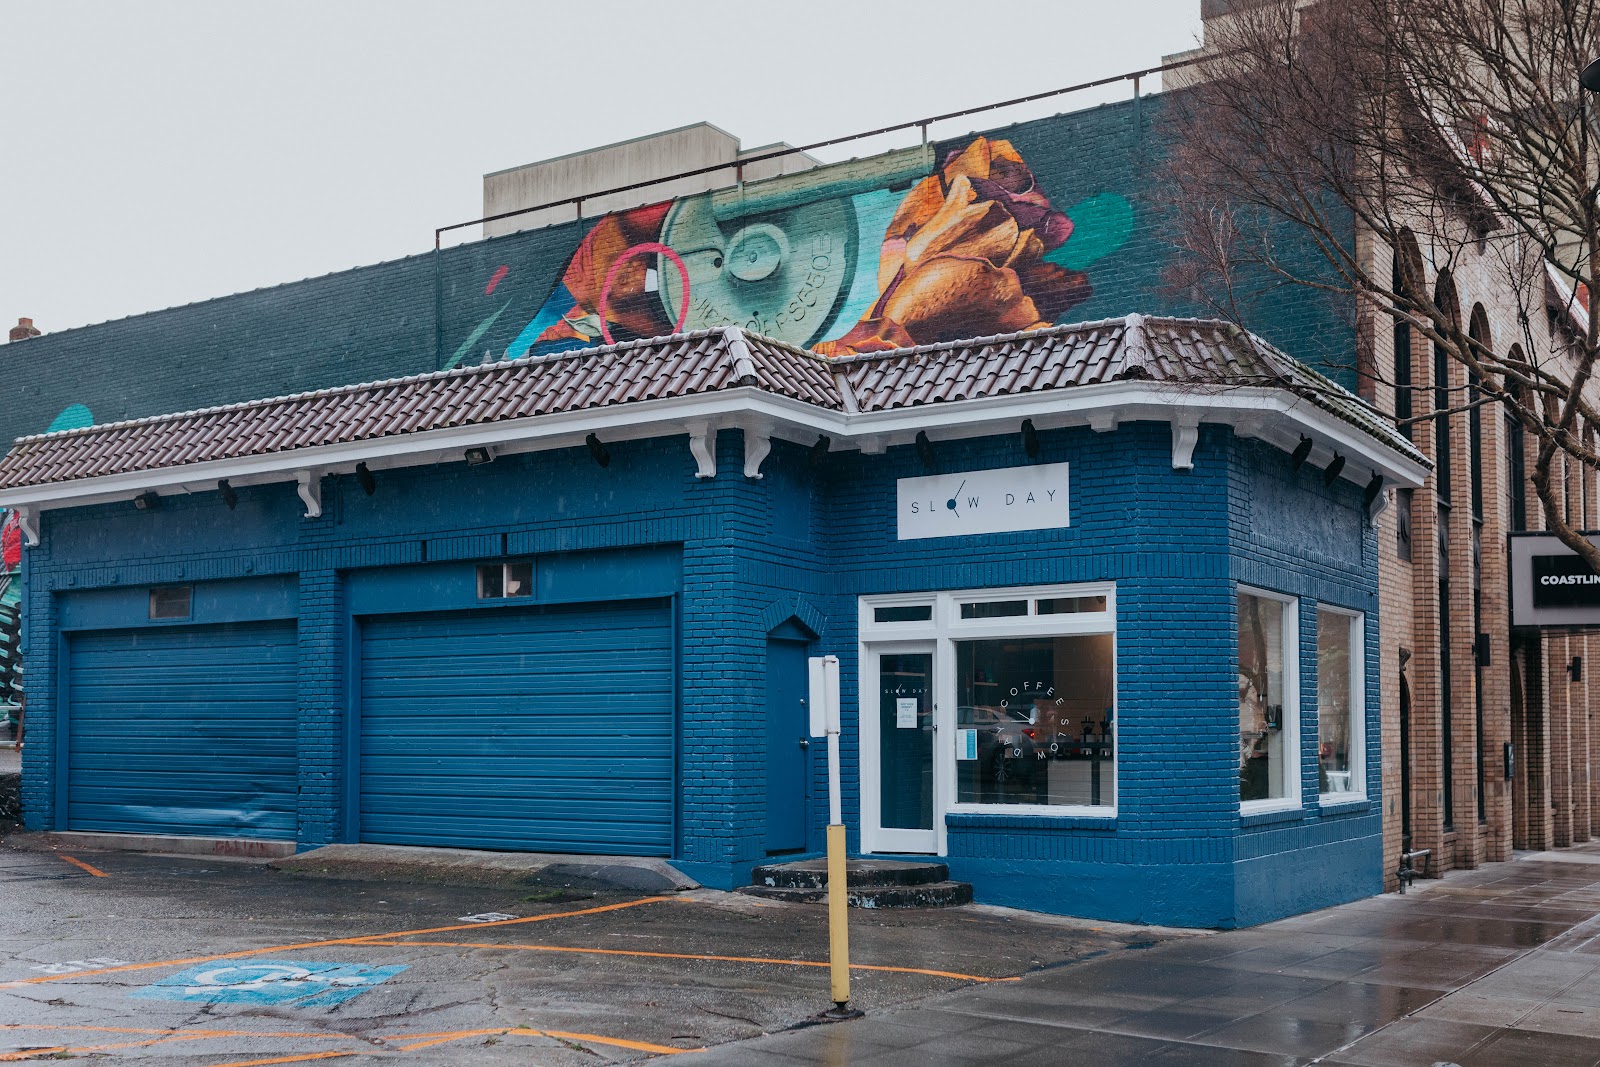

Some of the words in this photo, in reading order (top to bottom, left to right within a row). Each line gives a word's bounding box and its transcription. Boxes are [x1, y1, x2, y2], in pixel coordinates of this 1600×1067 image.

[1005, 489, 1056, 506] DAY
[1000, 681, 1064, 708] COFFEE
[996, 726, 1022, 757] DAY
